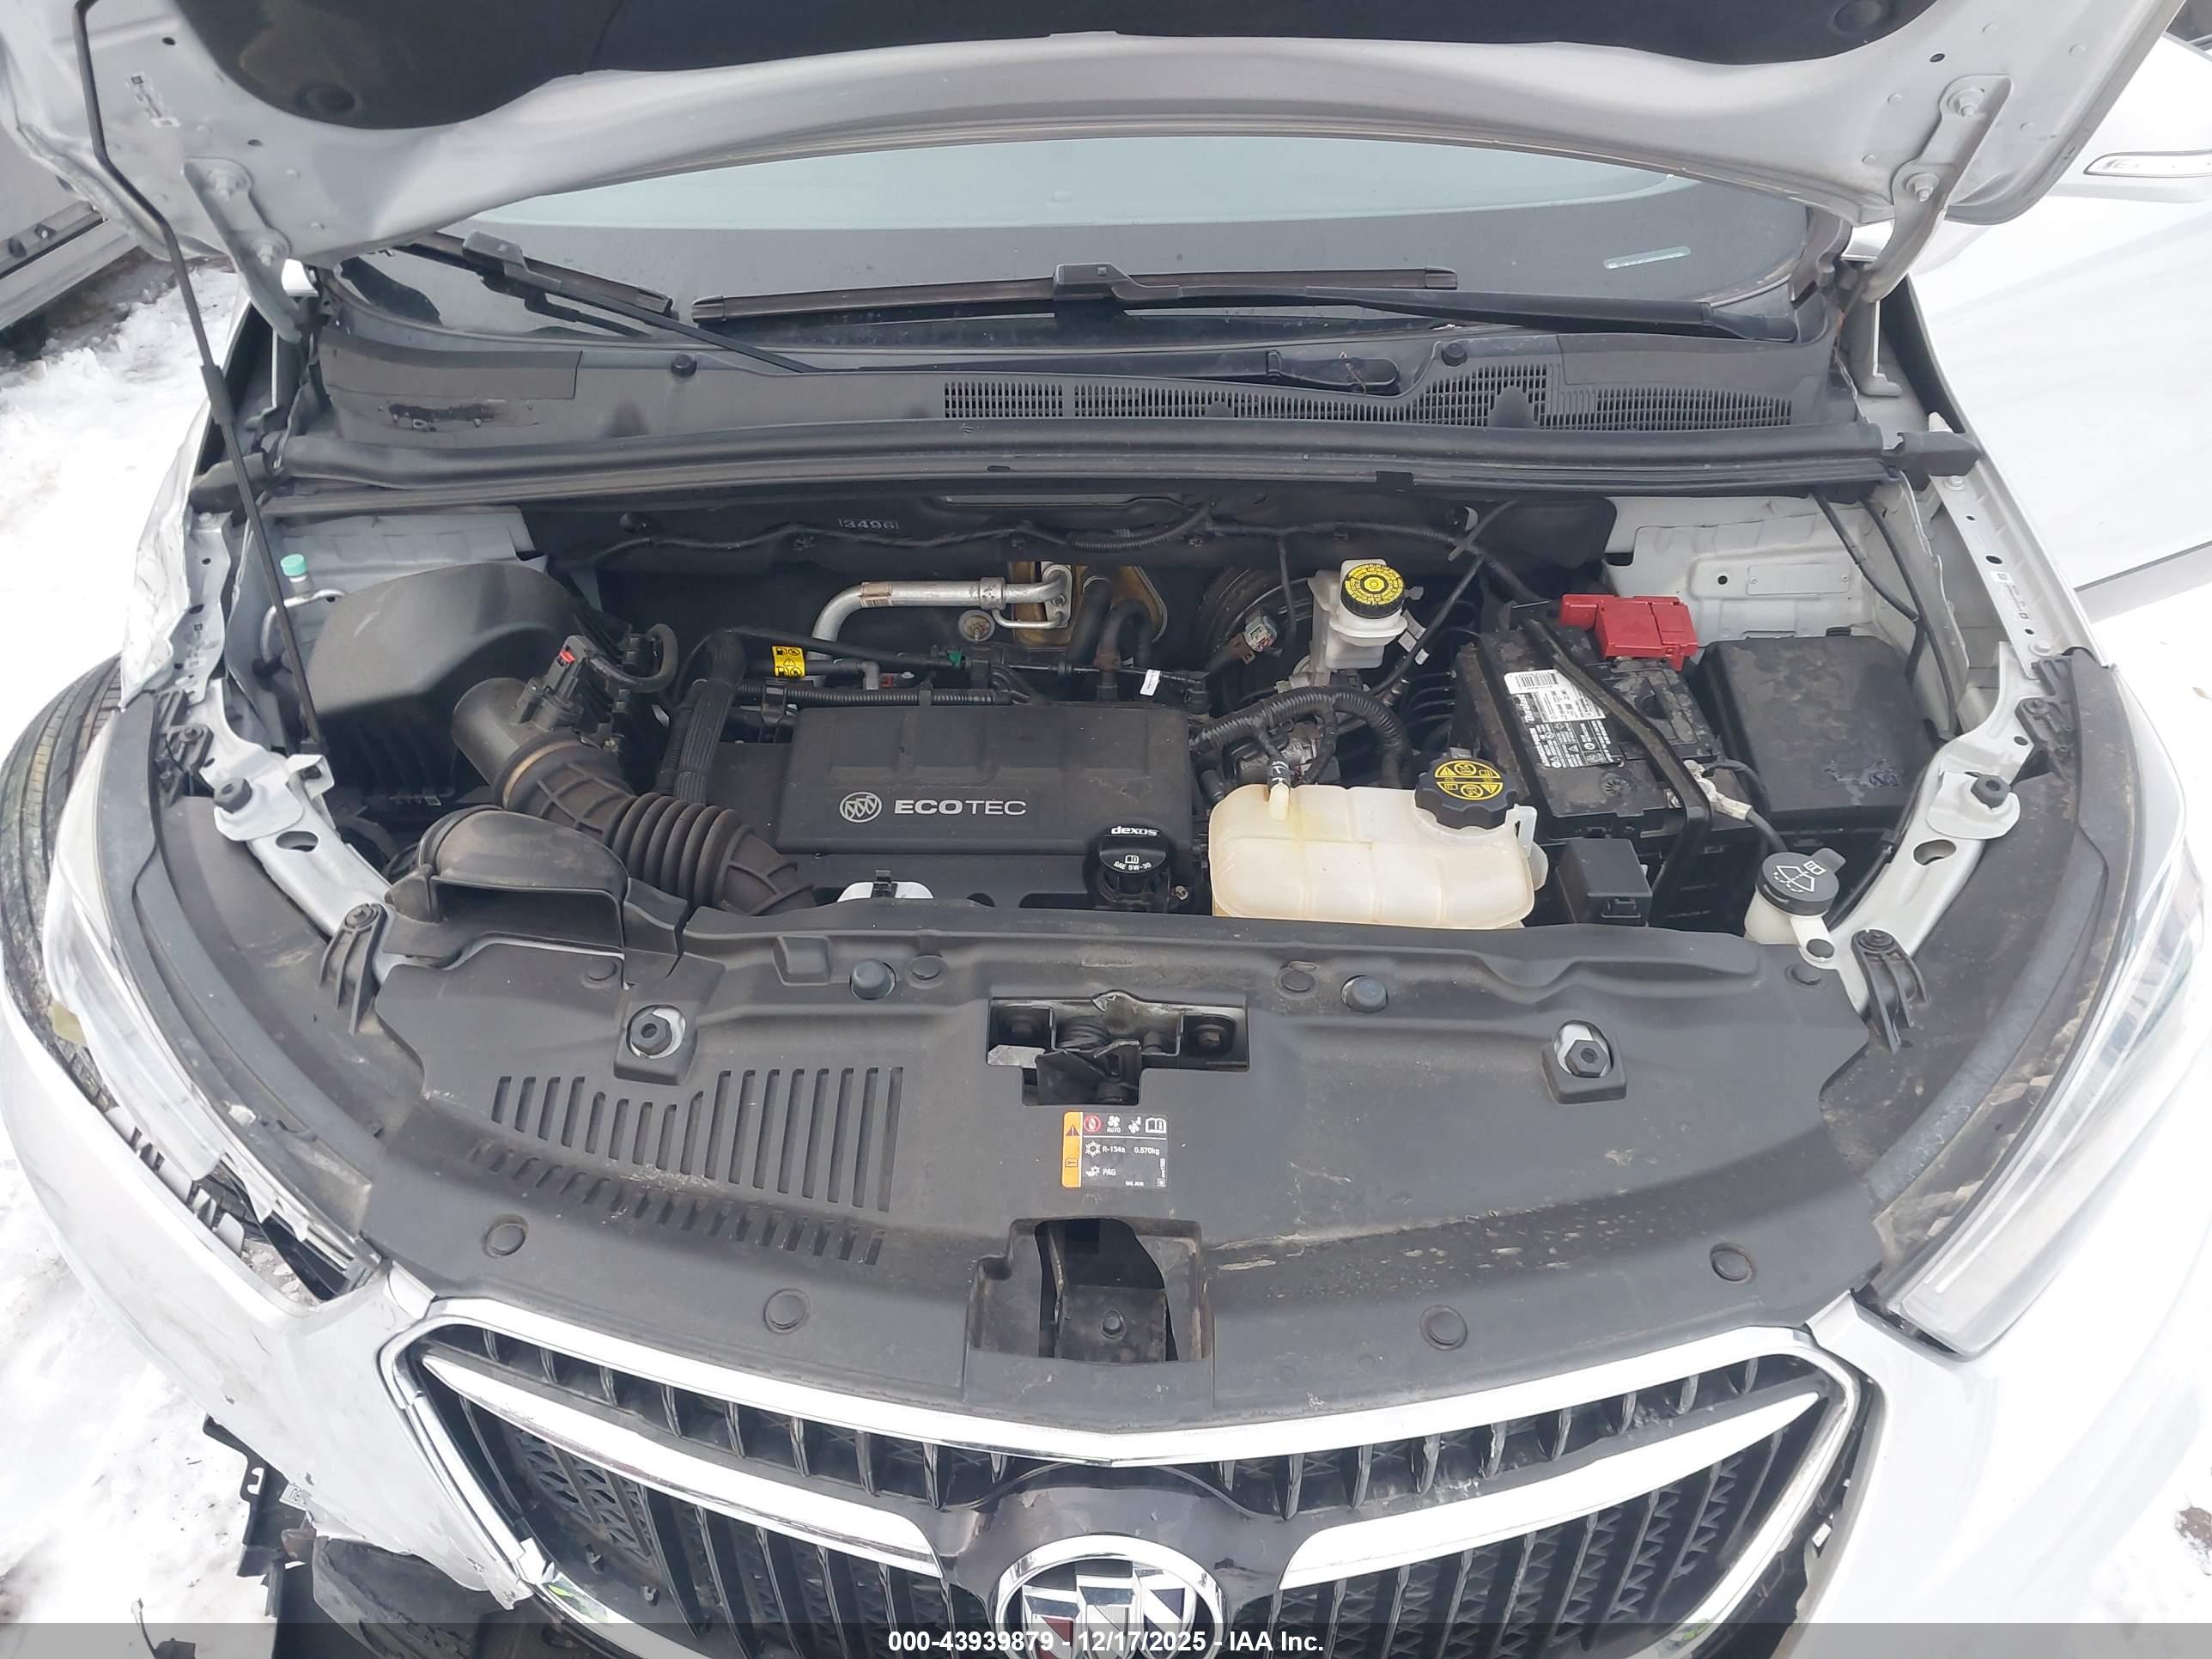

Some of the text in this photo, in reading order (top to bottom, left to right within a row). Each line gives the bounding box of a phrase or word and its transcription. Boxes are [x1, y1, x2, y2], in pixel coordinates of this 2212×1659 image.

[894, 799, 1026, 815] ECOTEC
[1110, 825, 1159, 836] dexos
[1113, 860, 1152, 871] SAE 5W-30
[1133, 1146, 1160, 1156] 0.570kg
[1103, 1168, 1116, 1176] PAG
